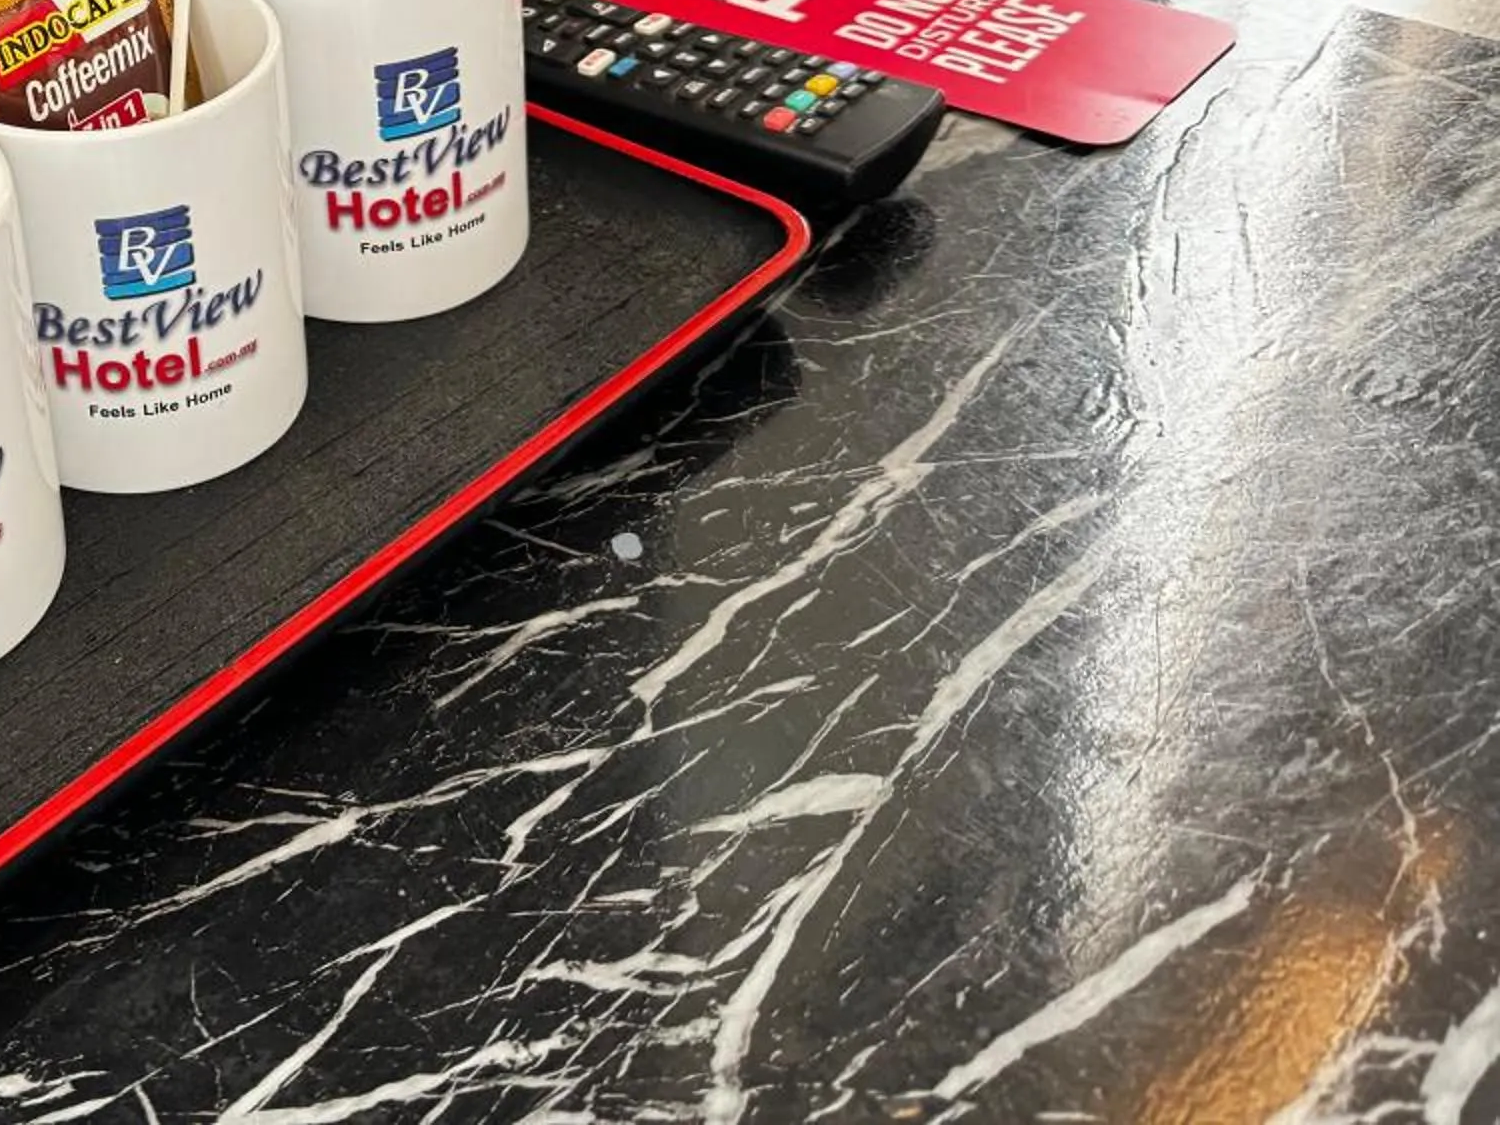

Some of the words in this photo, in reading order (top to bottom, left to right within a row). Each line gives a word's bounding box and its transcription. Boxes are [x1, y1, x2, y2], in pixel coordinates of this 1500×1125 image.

[833, 10, 917, 50] DO
[25, 25, 154, 122] Coffeemix
[124, 99, 137, 118] 1
[326, 171, 464, 231] Hotel
[360, 242, 405, 255] Feels
[411, 232, 443, 248] Like
[448, 213, 486, 237] Home
[52, 336, 202, 392] Hotel
[89, 404, 136, 418] Feels
[143, 399, 180, 416] Like
[185, 383, 232, 408] Home
